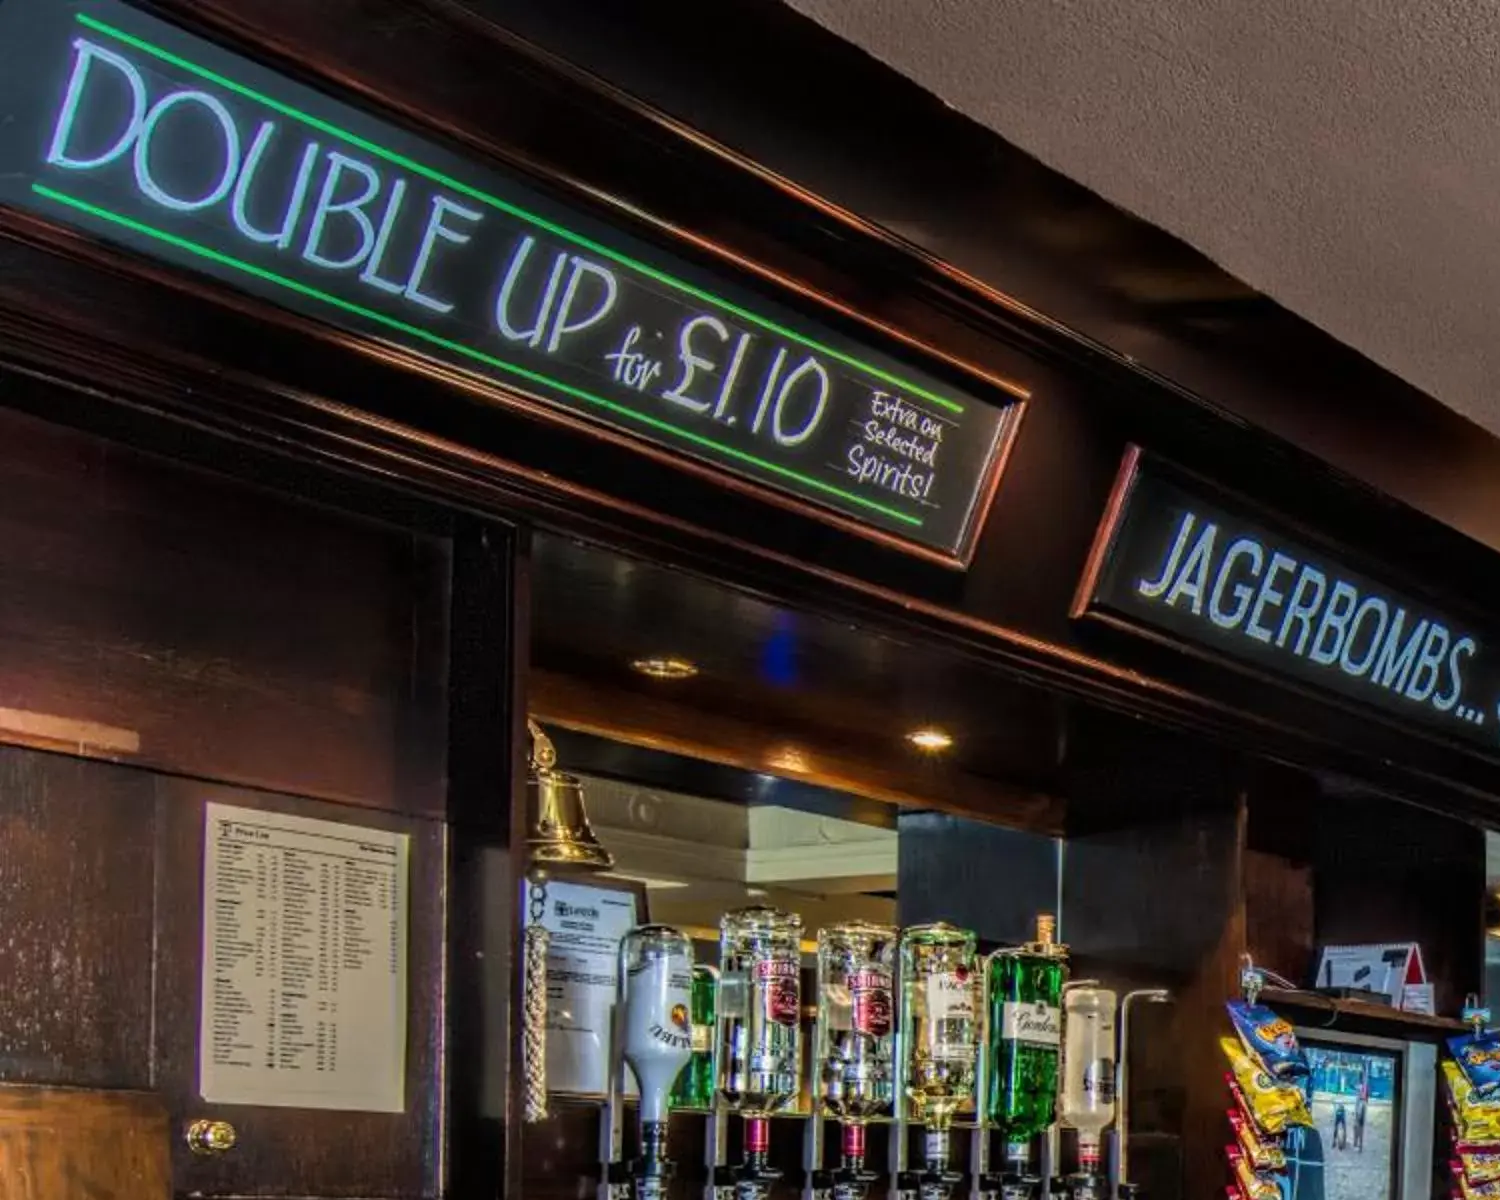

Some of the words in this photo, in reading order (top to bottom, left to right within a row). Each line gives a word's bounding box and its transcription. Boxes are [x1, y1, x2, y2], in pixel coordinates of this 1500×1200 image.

[46, 36, 484, 314] DOUBLE
[494, 235, 617, 354] UP
[604, 325, 662, 391] for
[662, 315, 830, 447] £1.10
[872, 391, 917, 430] Extra
[921, 417, 942, 442] on
[864, 420, 938, 467] Selected
[847, 444, 935, 498] Spirits!
